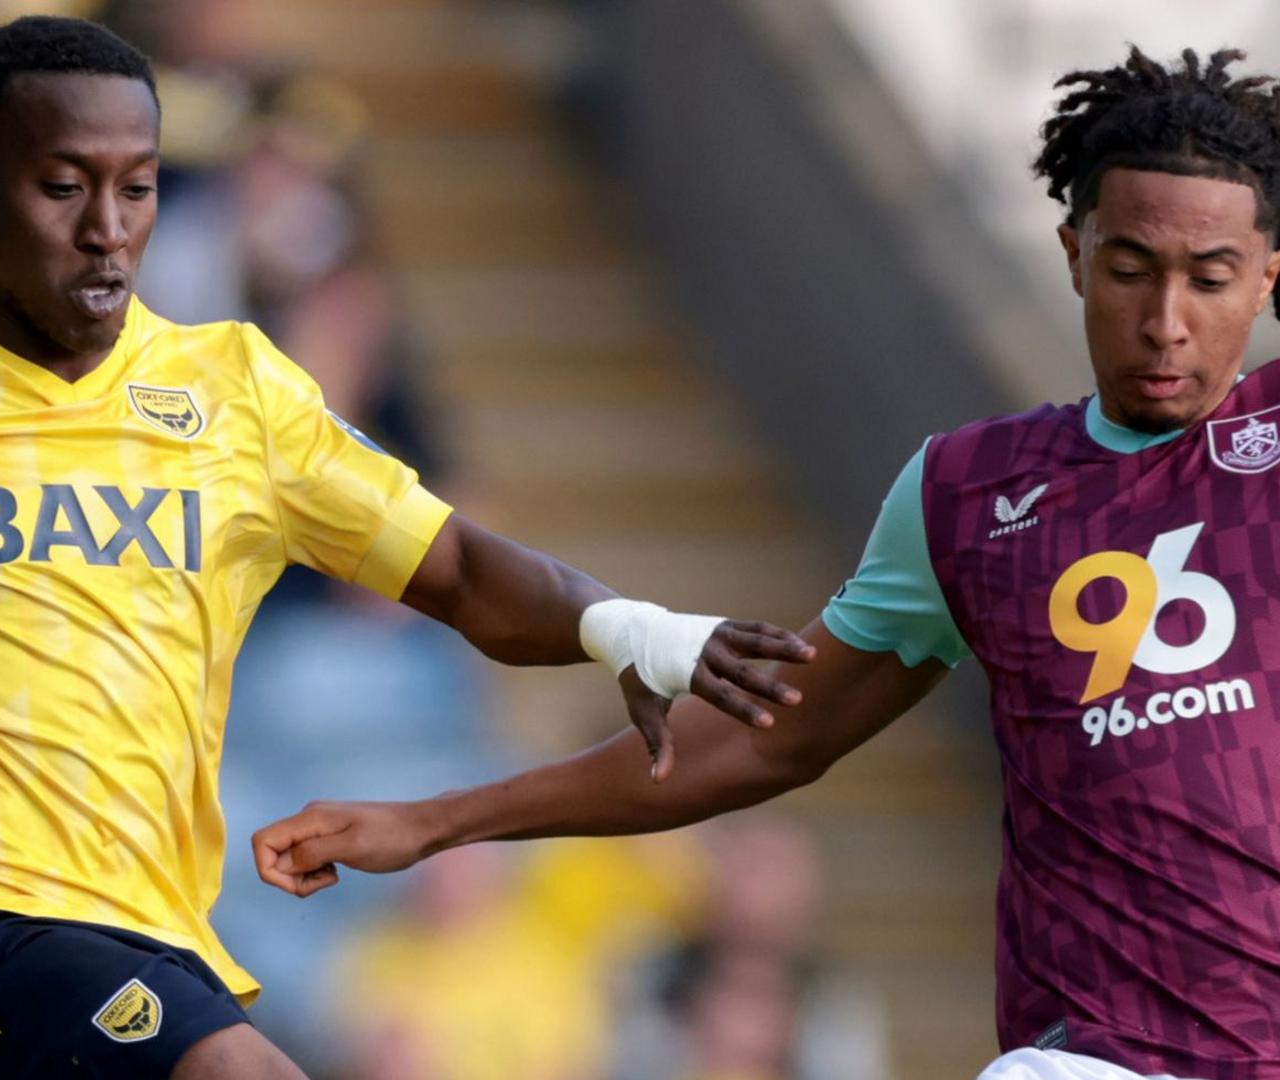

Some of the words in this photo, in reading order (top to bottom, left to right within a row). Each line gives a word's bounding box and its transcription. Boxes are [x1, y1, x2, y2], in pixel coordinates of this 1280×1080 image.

[136, 391, 185, 403] OXFORD
[1048, 521, 1237, 706] 96
[1081, 678, 1256, 747] 96.com
